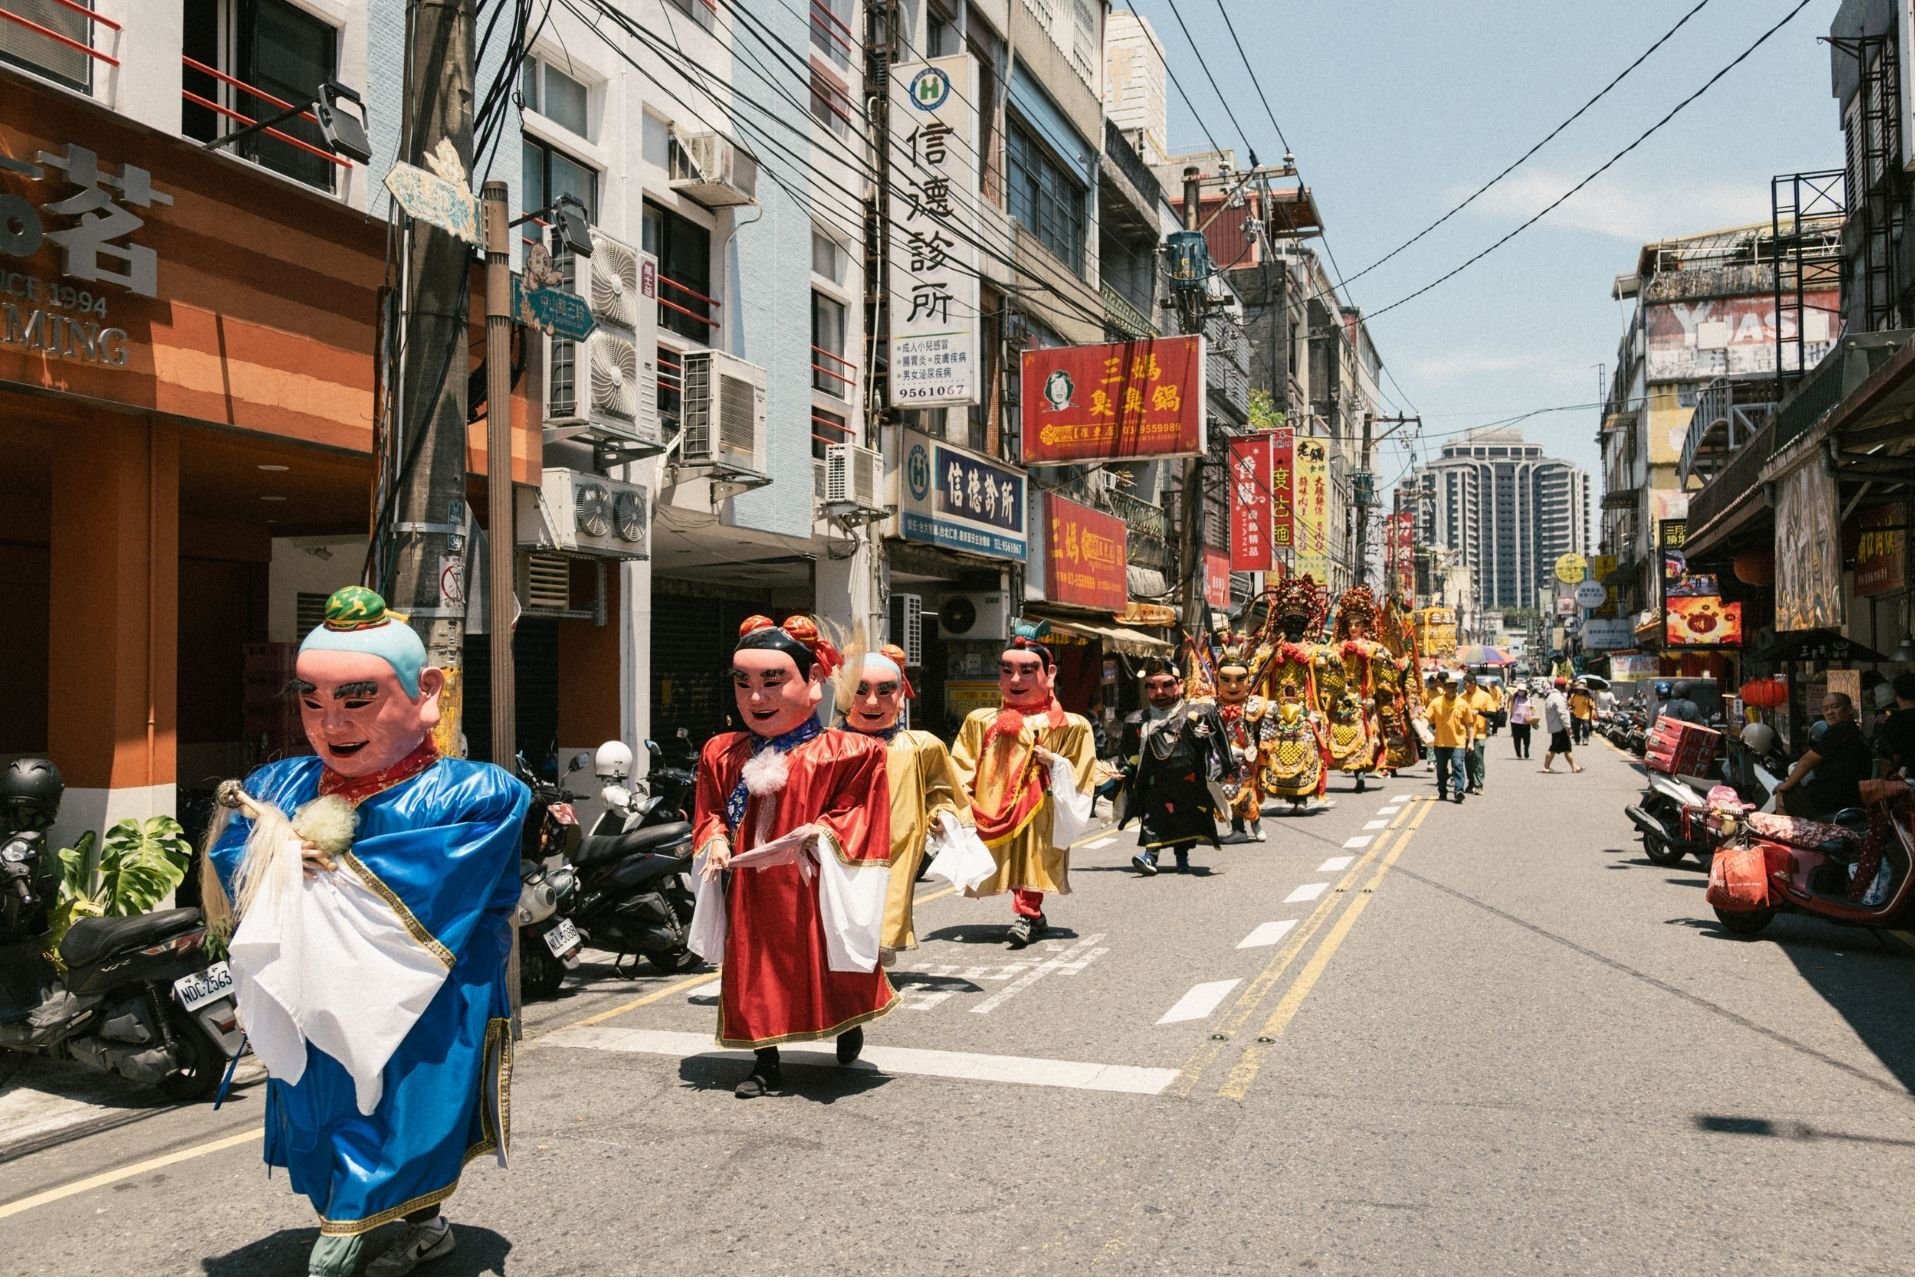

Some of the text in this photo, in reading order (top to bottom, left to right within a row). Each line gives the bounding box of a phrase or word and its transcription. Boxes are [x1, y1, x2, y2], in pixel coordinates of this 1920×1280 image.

[906, 122, 954, 324] 信德診所
[48, 282, 107, 319] 1994
[2, 303, 128, 366] MING
[902, 339, 949, 352] 成人小兒感冒
[902, 367, 952, 380] 男女泌尿疾病
[934, 352, 967, 364] 皮膚疾病
[1101, 352, 1162, 385] 三媽
[900, 385, 965, 398] 9561067
[1089, 384, 1181, 417] 臭臭鍋
[948, 461, 1014, 524] 信德診所
[1051, 517, 1079, 565] 三媽
[180, 970, 233, 1004] NDC-2563
